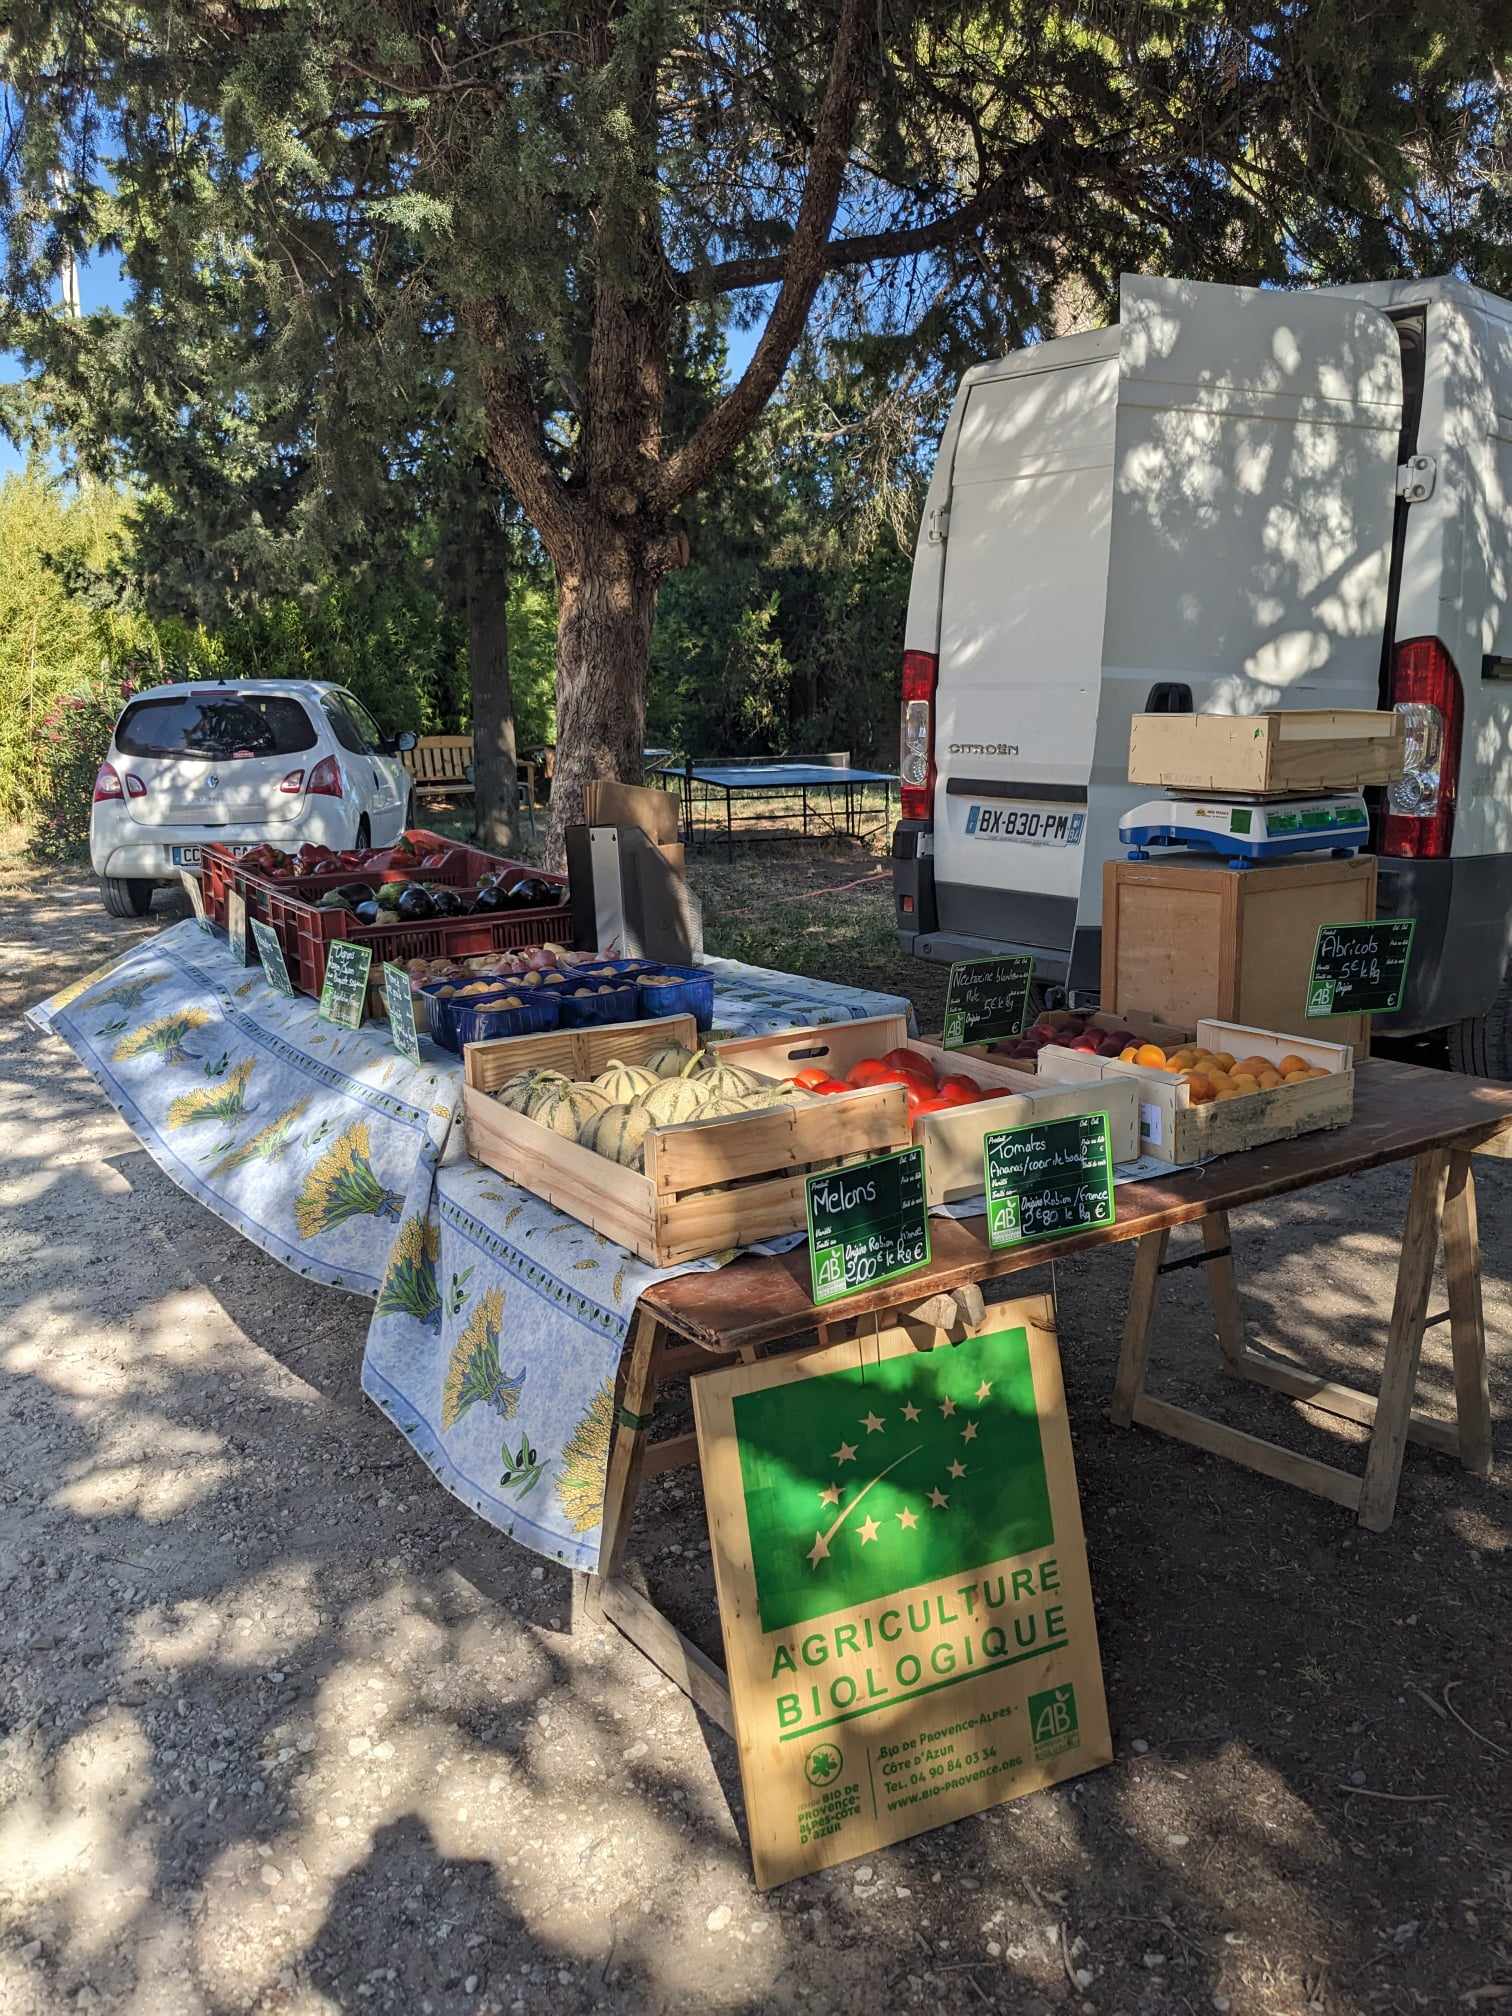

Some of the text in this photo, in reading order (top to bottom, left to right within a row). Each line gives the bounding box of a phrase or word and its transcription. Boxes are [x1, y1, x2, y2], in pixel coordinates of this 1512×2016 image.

[949, 744, 1019, 756] CITROËN
[980, 810, 1068, 839] BX-830-PM
[1322, 934, 1378, 957] Abricots
[1312, 989, 1329, 1005] AB
[948, 1021, 962, 1036] AB
[990, 1132, 1046, 1159] Tomates
[814, 1181, 876, 1216] Melons
[1095, 1202, 1106, 1218] €
[995, 1208, 1016, 1231] AB
[914, 1242, 923, 1259] €
[819, 1258, 840, 1284] AB
[772, 1559, 1061, 1679] AGRICULTURE
[776, 1605, 1068, 1728] BIOLOGIQUE
[1036, 1702, 1072, 1741] AB
[910, 1770, 927, 1785] 04
[929, 1764, 945, 1778] 90
[947, 1756, 963, 1772] 84
[965, 1753, 980, 1766] 03
